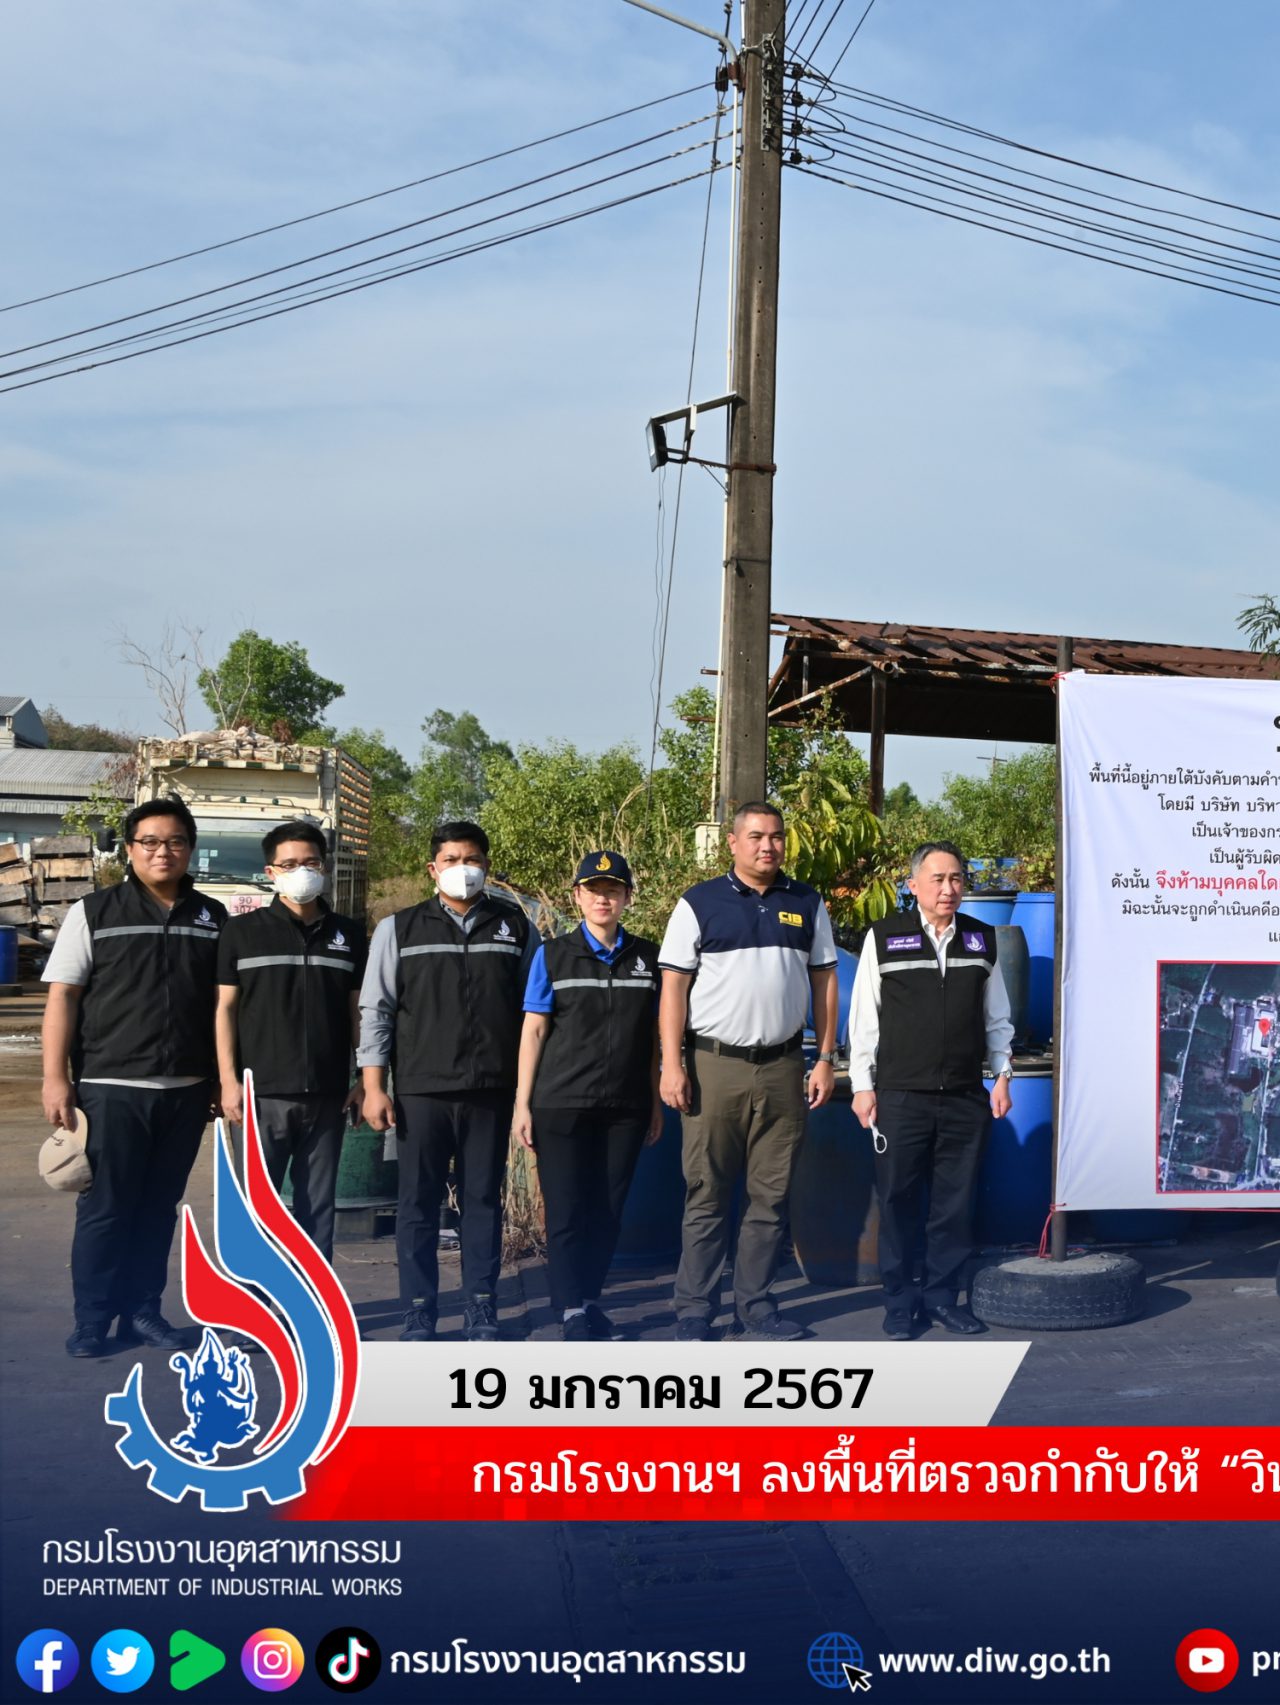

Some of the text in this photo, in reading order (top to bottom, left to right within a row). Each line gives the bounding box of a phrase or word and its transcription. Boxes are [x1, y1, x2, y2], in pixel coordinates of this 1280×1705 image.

[1158, 793, 1194, 810] โดยมี
[1201, 796, 1239, 811] บริษัท
[1112, 868, 1150, 888] ดังนั้น
[239, 896, 253, 904] 90
[778, 911, 803, 924] CIB
